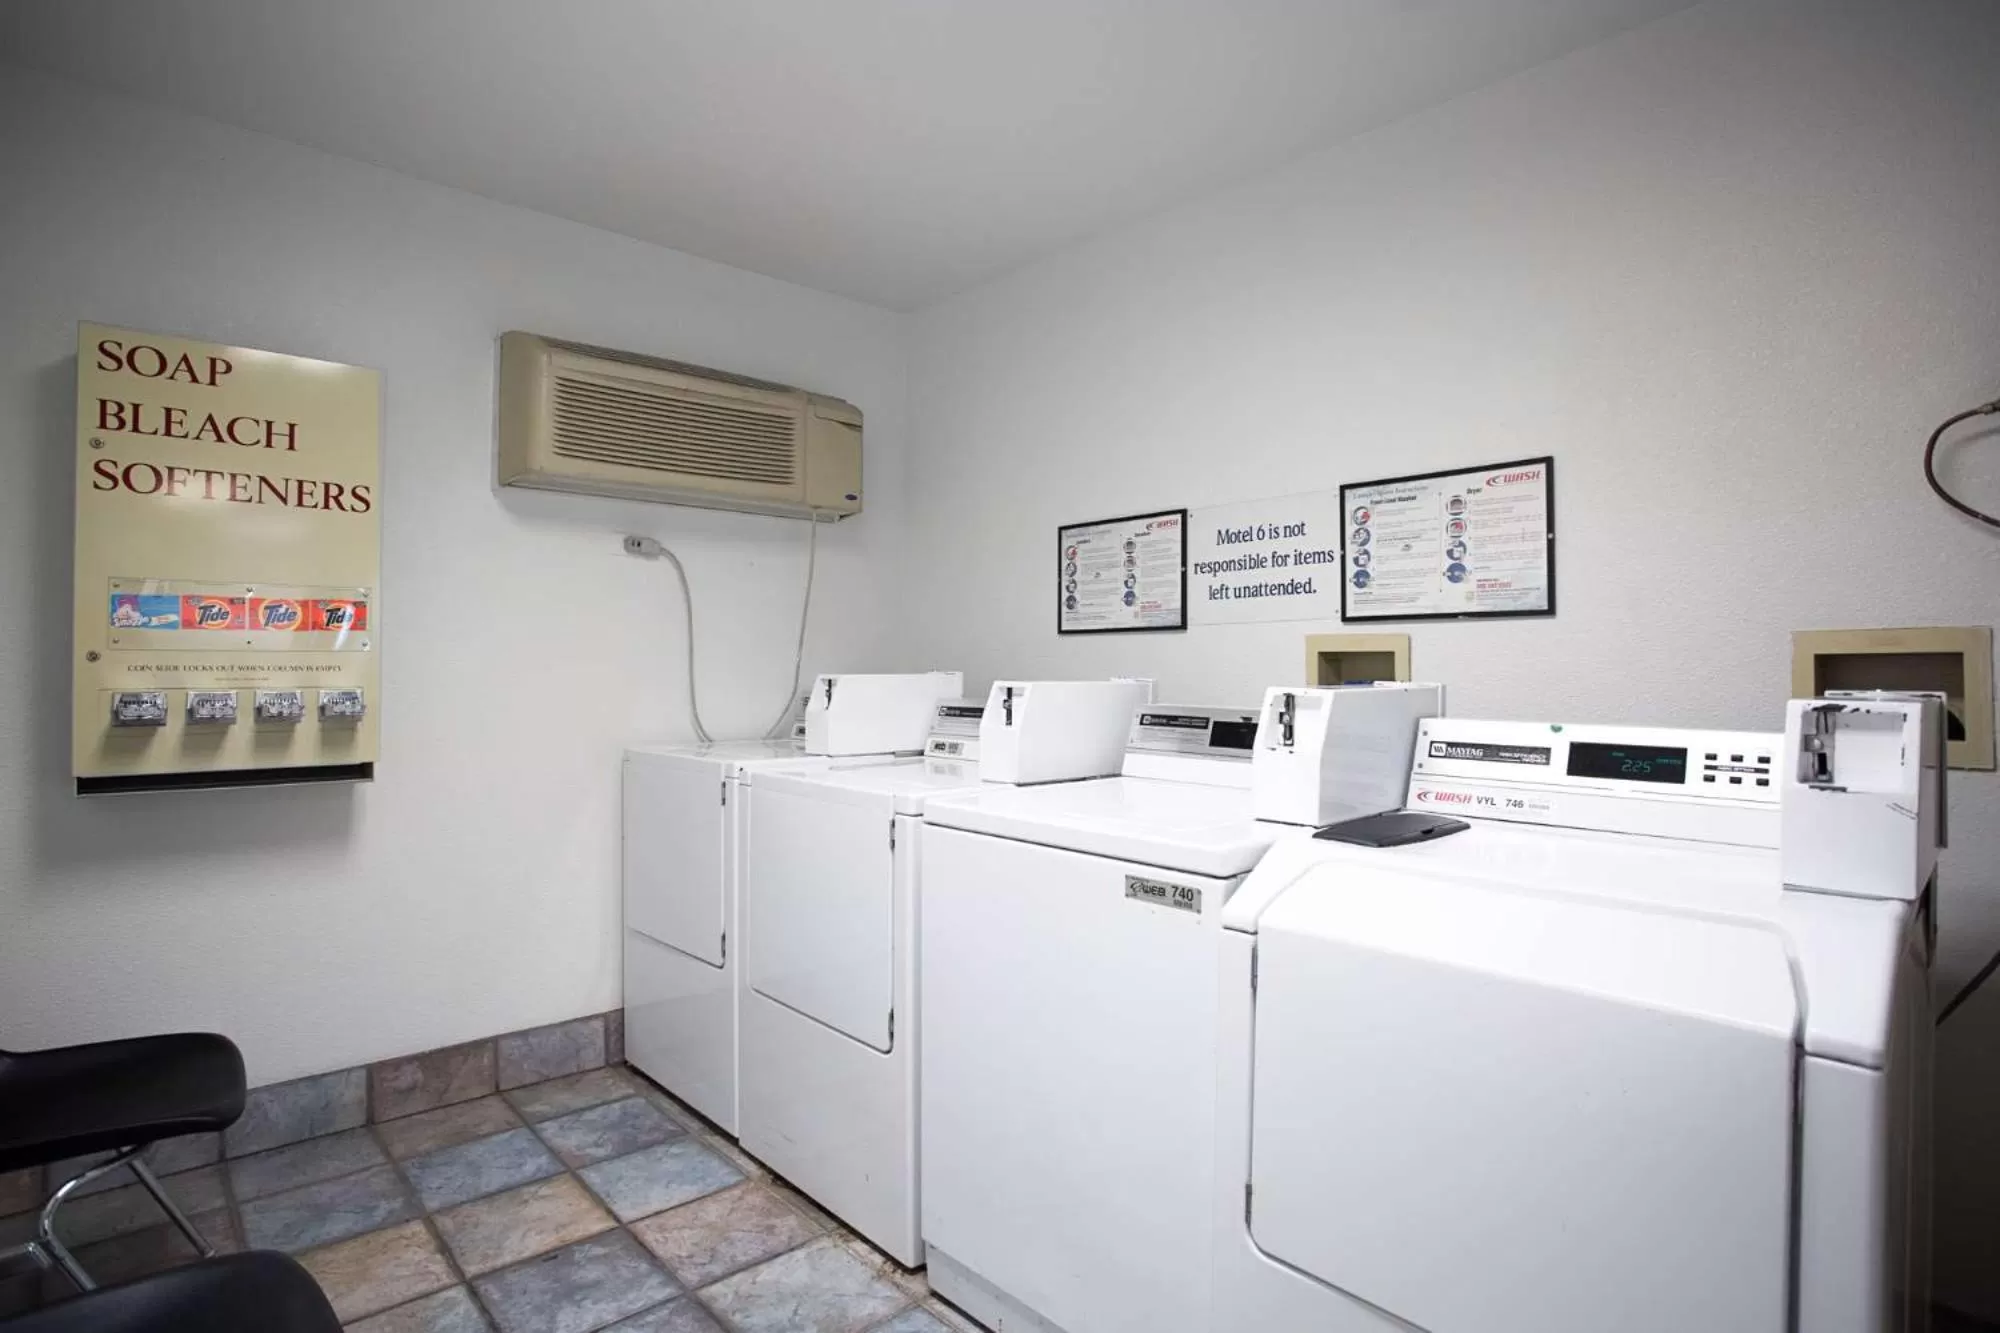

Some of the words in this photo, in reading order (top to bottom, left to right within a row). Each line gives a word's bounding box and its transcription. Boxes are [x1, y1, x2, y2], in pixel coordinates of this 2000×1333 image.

[96, 339, 233, 387] SOAP
[96, 397, 299, 451] BLEACH
[93, 459, 371, 513] SOFTENERS
[1216, 526, 1253, 546] Motel
[1256, 524, 1265, 541] 6
[1268, 523, 1280, 540] is
[1283, 521, 1306, 538] not
[1194, 554, 1268, 577] responsible
[1271, 551, 1290, 568] for
[1293, 549, 1335, 566] items
[1208, 584, 1230, 600] left
[1233, 577, 1317, 599] unattended.
[198, 604, 230, 625] Tide
[263, 604, 297, 627] Tide
[1447, 747, 1484, 757] MAYTAG
[1476, 795, 1496, 806] VYL
[1505, 798, 1524, 809] 746
[1171, 885, 1194, 902] 740
